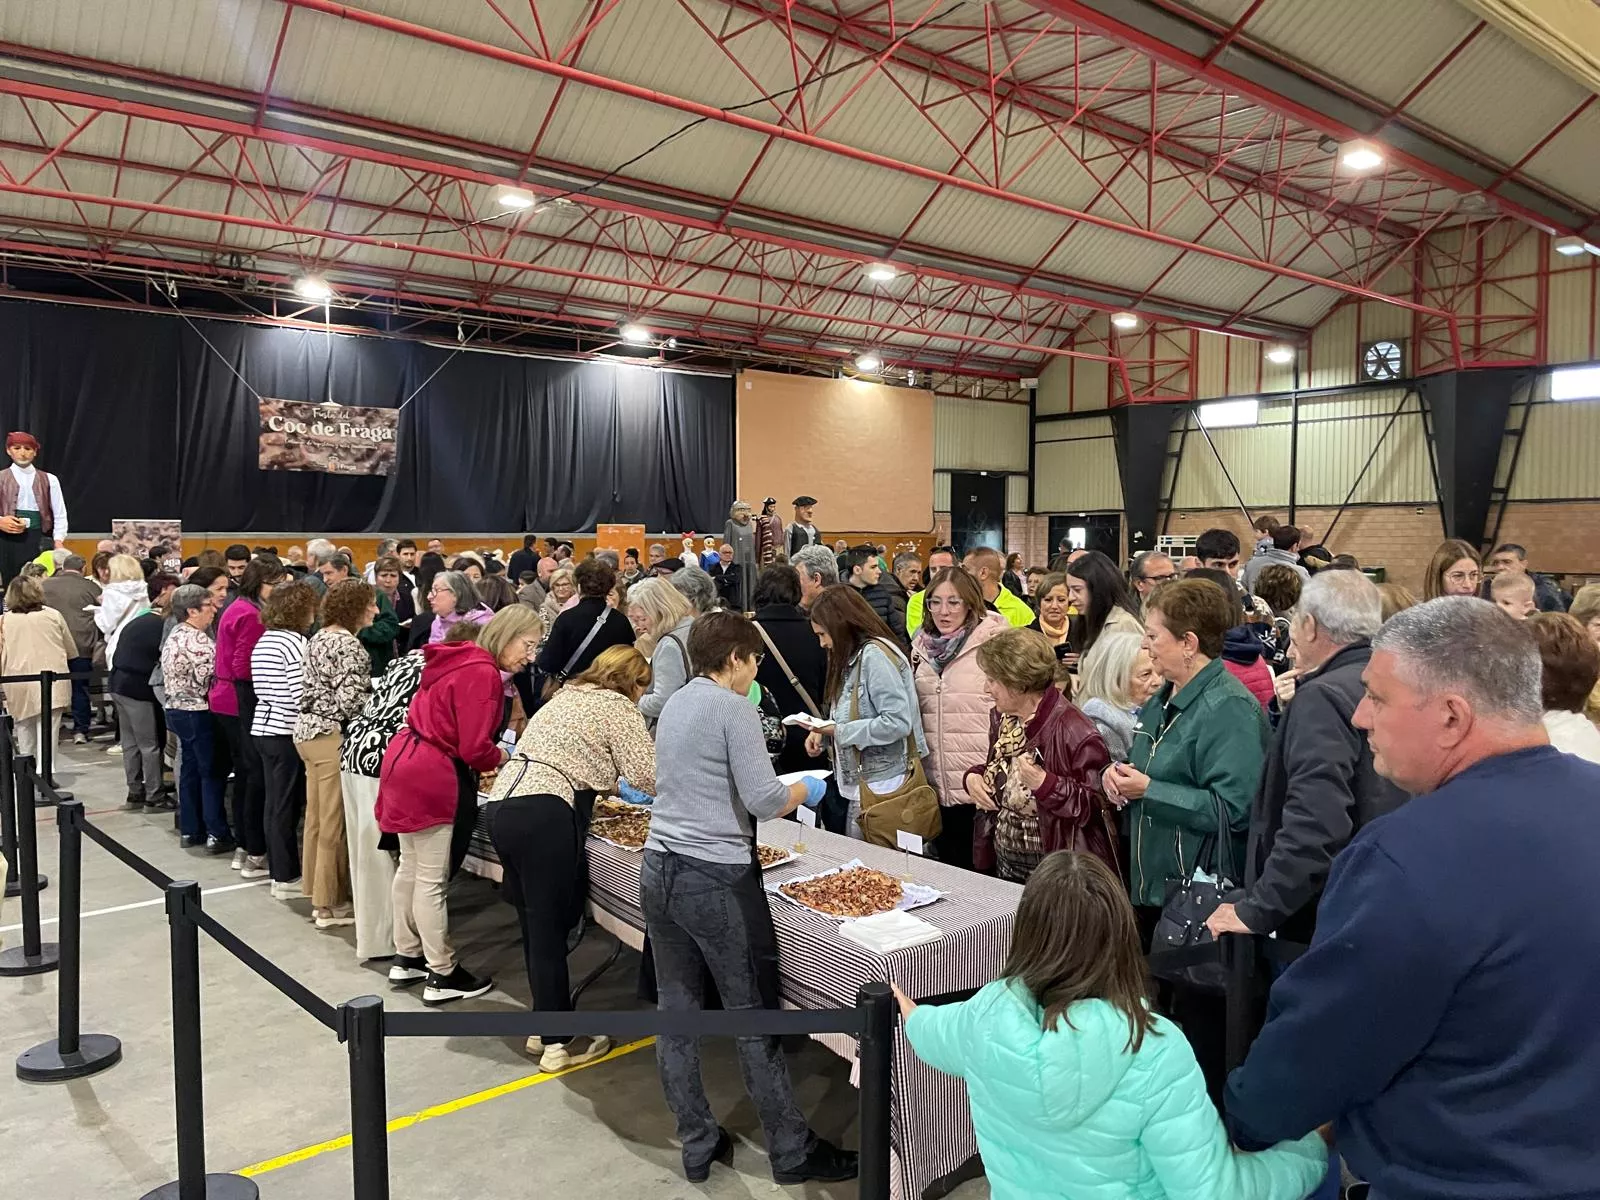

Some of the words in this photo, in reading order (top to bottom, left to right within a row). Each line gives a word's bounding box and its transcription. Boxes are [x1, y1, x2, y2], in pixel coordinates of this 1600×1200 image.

[268, 416, 306, 434] Coc
[311, 422, 335, 437] de
[340, 423, 392, 442] Fraga
